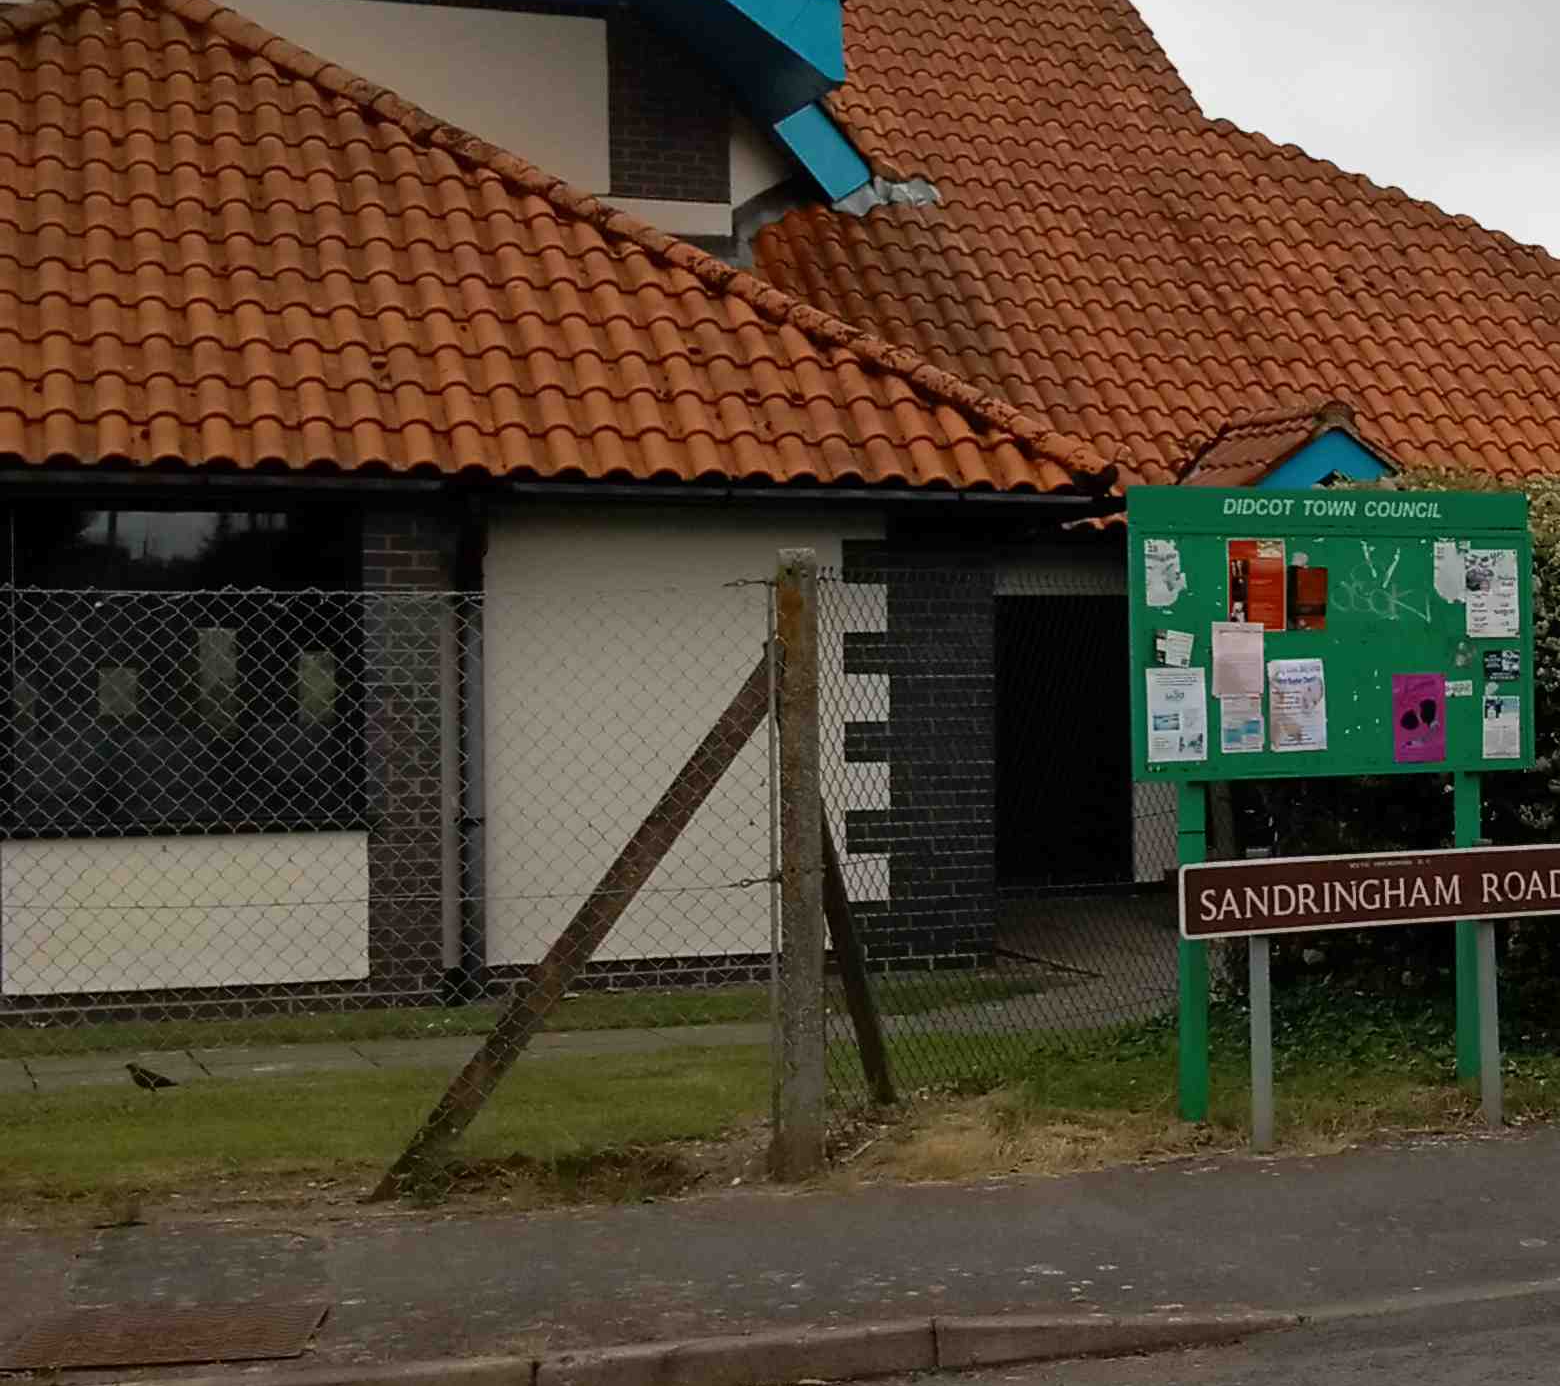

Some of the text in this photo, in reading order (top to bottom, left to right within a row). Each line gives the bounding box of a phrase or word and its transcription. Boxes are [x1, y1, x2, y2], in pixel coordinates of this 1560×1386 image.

[1223, 498, 1442, 519] DIDCOT TOWN COUNCIL
[1200, 874, 1463, 921] SANDRINGHAM
